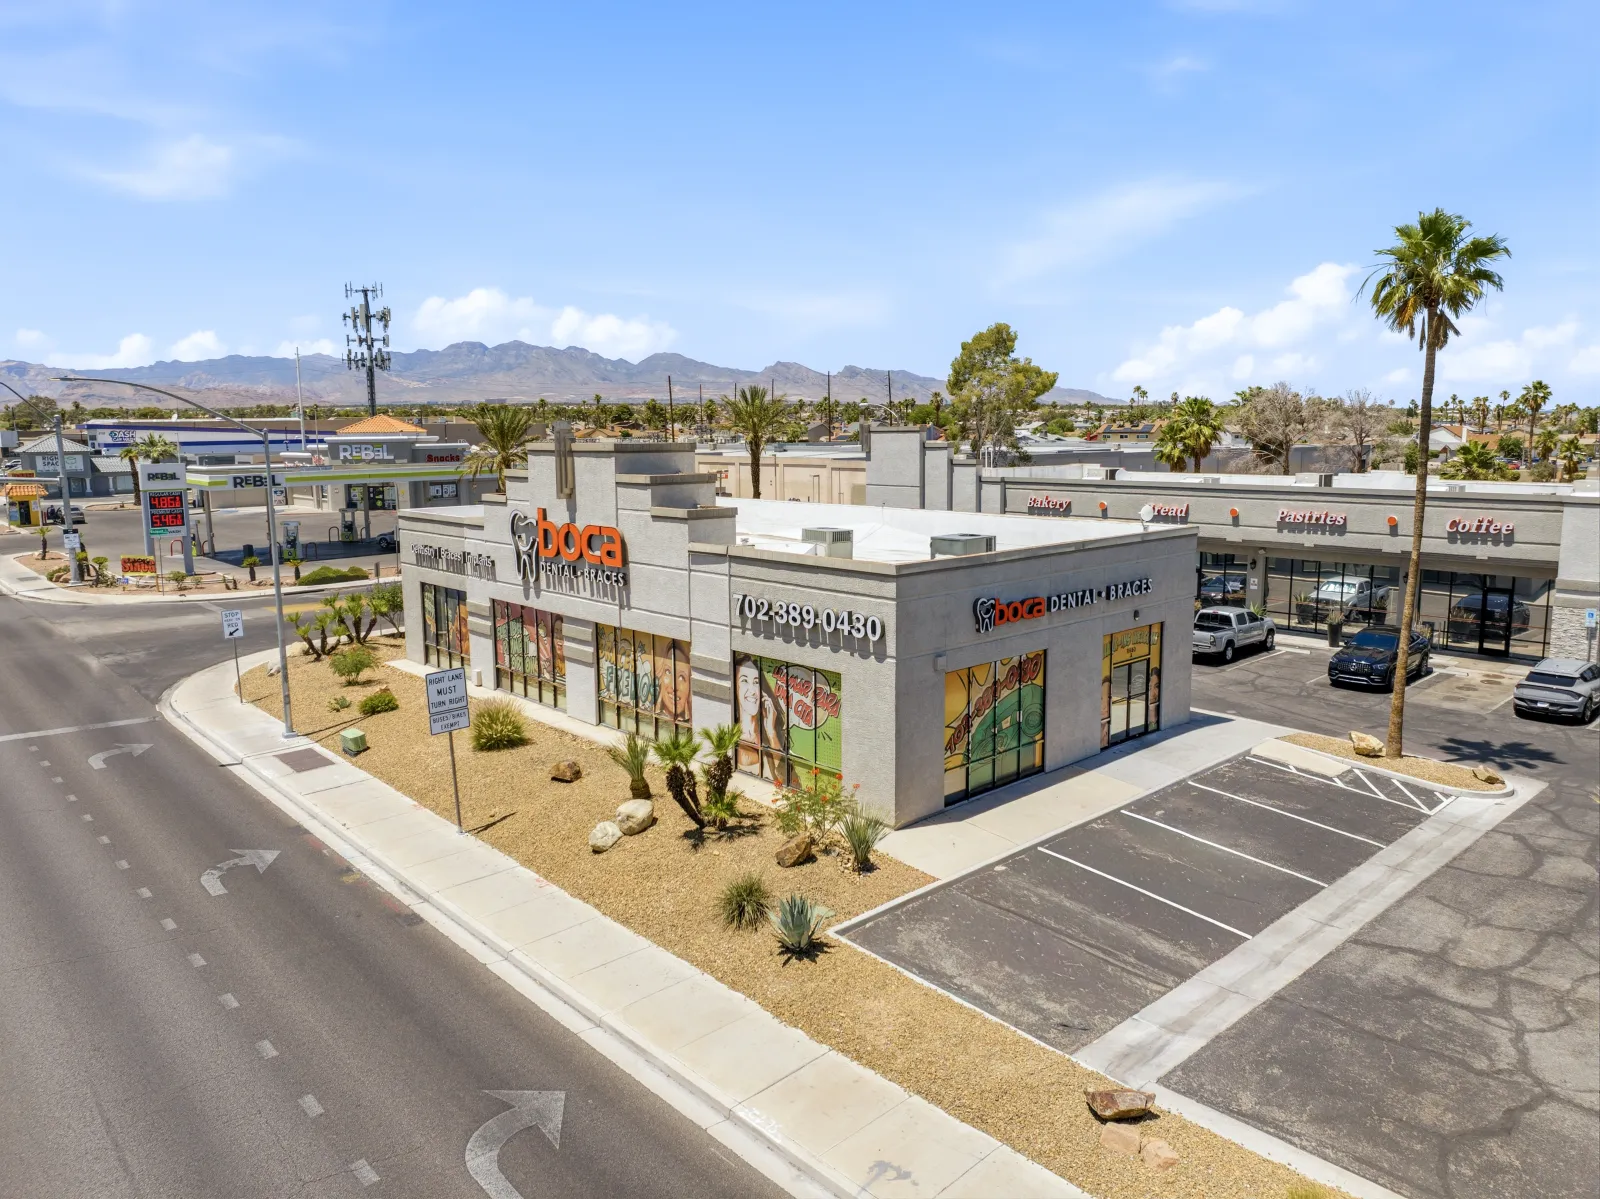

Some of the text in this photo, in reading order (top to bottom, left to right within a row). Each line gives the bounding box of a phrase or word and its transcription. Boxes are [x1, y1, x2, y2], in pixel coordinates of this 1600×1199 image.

[110, 430, 136, 438] DASH
[339, 444, 394, 460] REBEL
[426, 454, 460, 462] Snacks
[147, 472, 181, 481] REBEL
[1027, 495, 1071, 512] Bakery
[1153, 503, 1188, 517] read
[1275, 508, 1346, 527] Pastries
[1446, 516, 1514, 535] Coffee
[537, 507, 624, 568] boca
[465, 552, 492, 567] Implants
[540, 562, 625, 587] DENTAL BRACES
[994, 578, 1153, 627] boca DENTAL BRACES
[732, 593, 882, 642] 702-389-0430
[428, 672, 463, 686] RIGHT LANE
[436, 685, 457, 697] MUST
[430, 695, 466, 709] TURN RIGHT
[811, 686, 841, 718] PARA
[793, 699, 813, 727] CITA
[440, 720, 461, 731] EXEMPT
